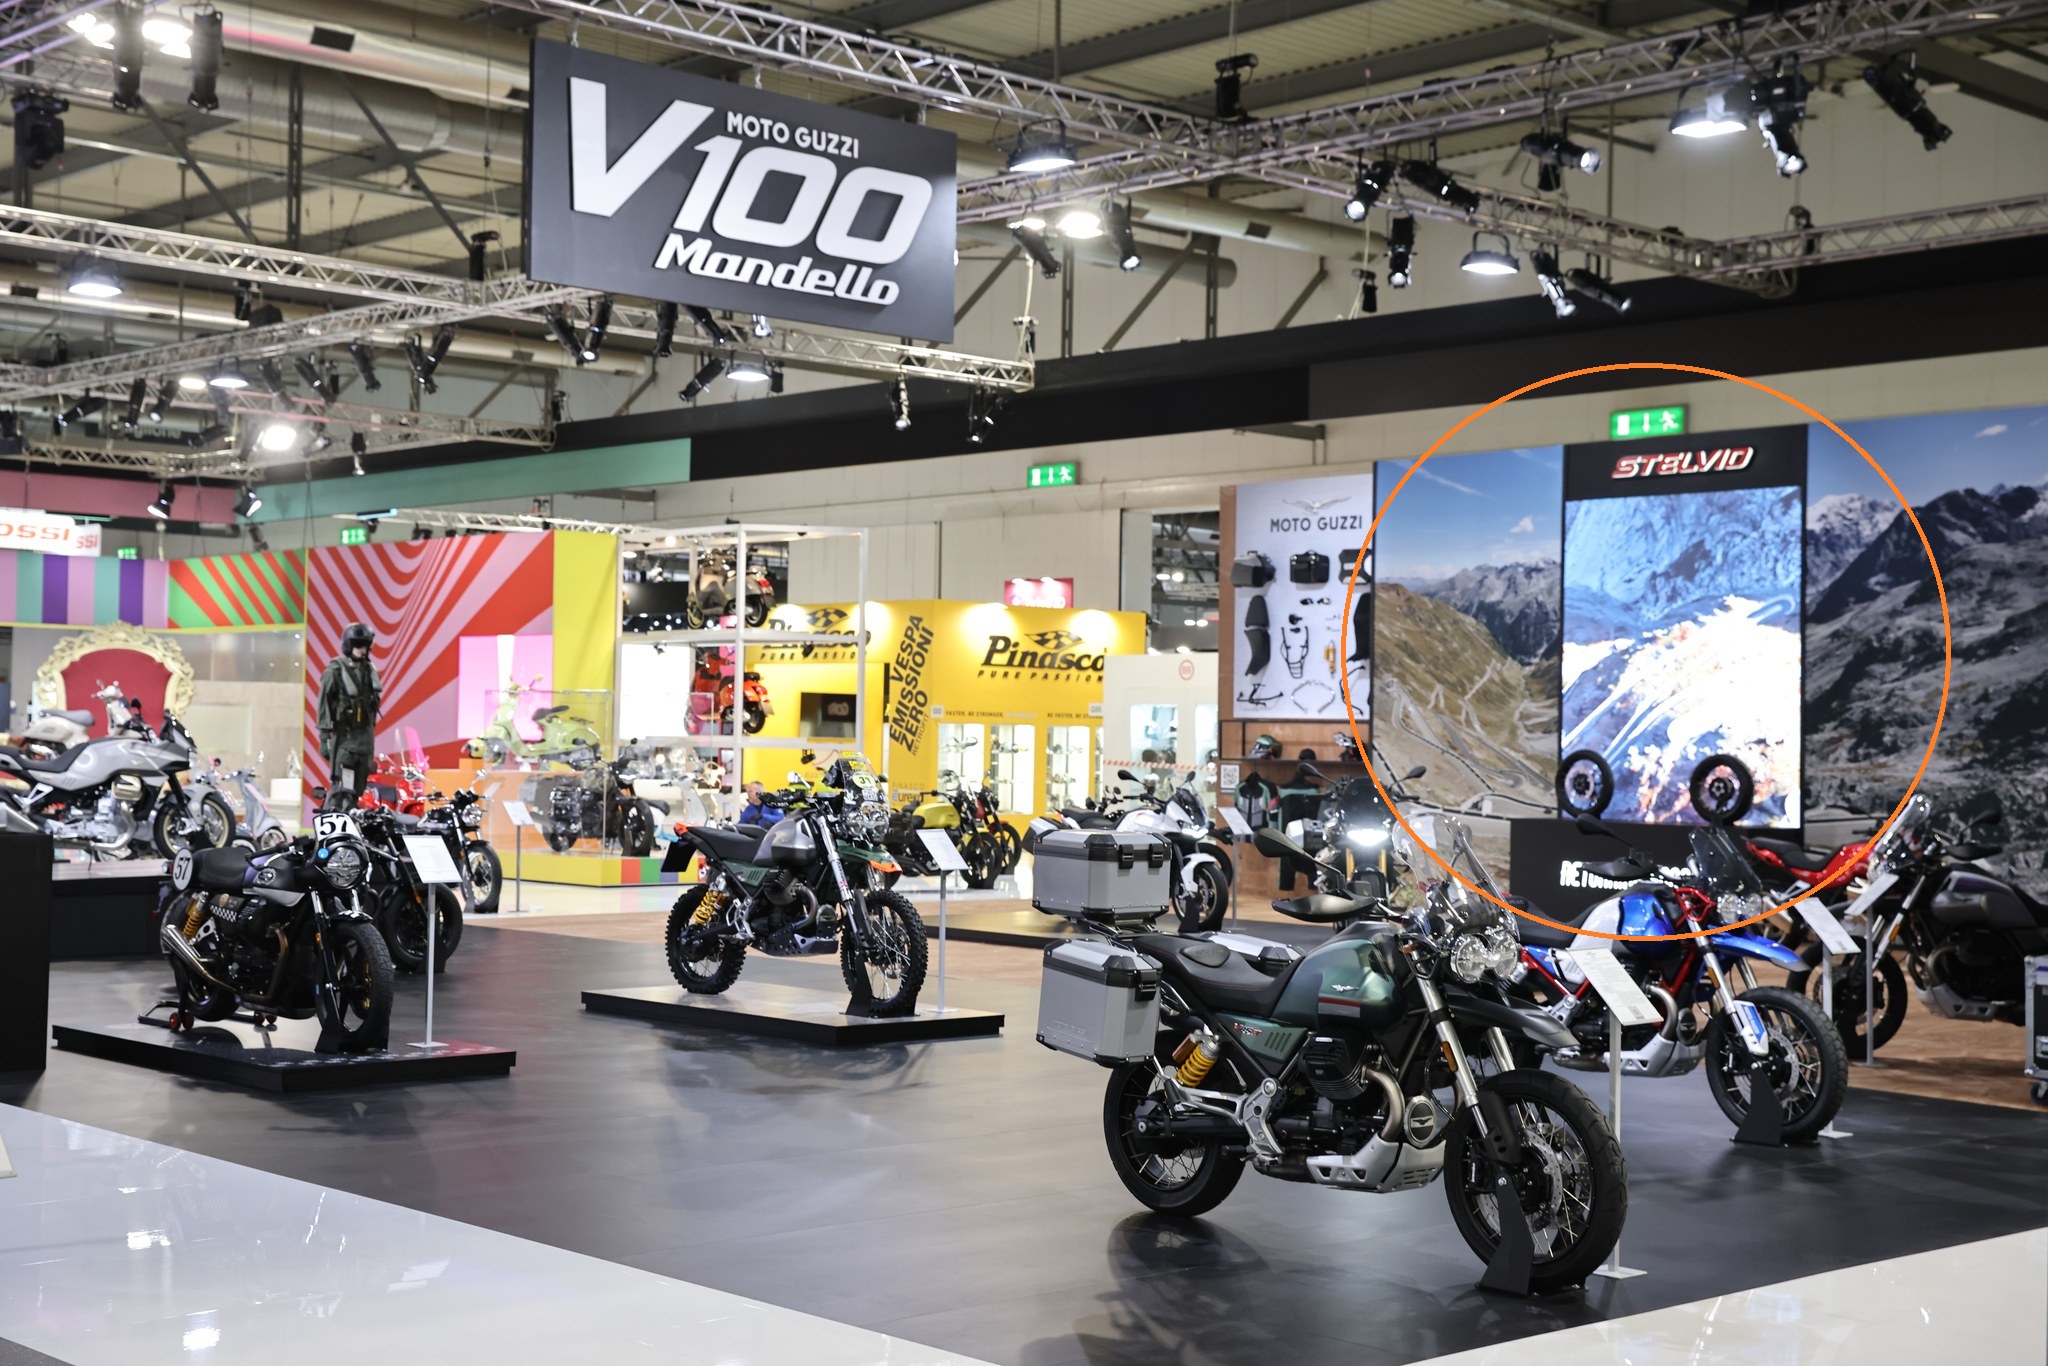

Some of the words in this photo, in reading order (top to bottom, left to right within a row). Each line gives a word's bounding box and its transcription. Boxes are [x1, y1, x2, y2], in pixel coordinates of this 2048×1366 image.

[727, 111, 790, 144] MOTO
[794, 126, 859, 159] GUZZI
[569, 76, 933, 264] V100
[654, 232, 900, 306] Mandello
[1611, 446, 1755, 479] STELVIO
[1269, 517, 1311, 533] MOTO
[1317, 514, 1363, 531] GUZZI
[889, 614, 923, 683] VESPA
[889, 625, 934, 747] EMISSIONI
[977, 669, 1021, 680] PURE
[900, 690, 929, 753] ZERO
[319, 814, 348, 836] 57
[174, 857, 192, 881] 57
